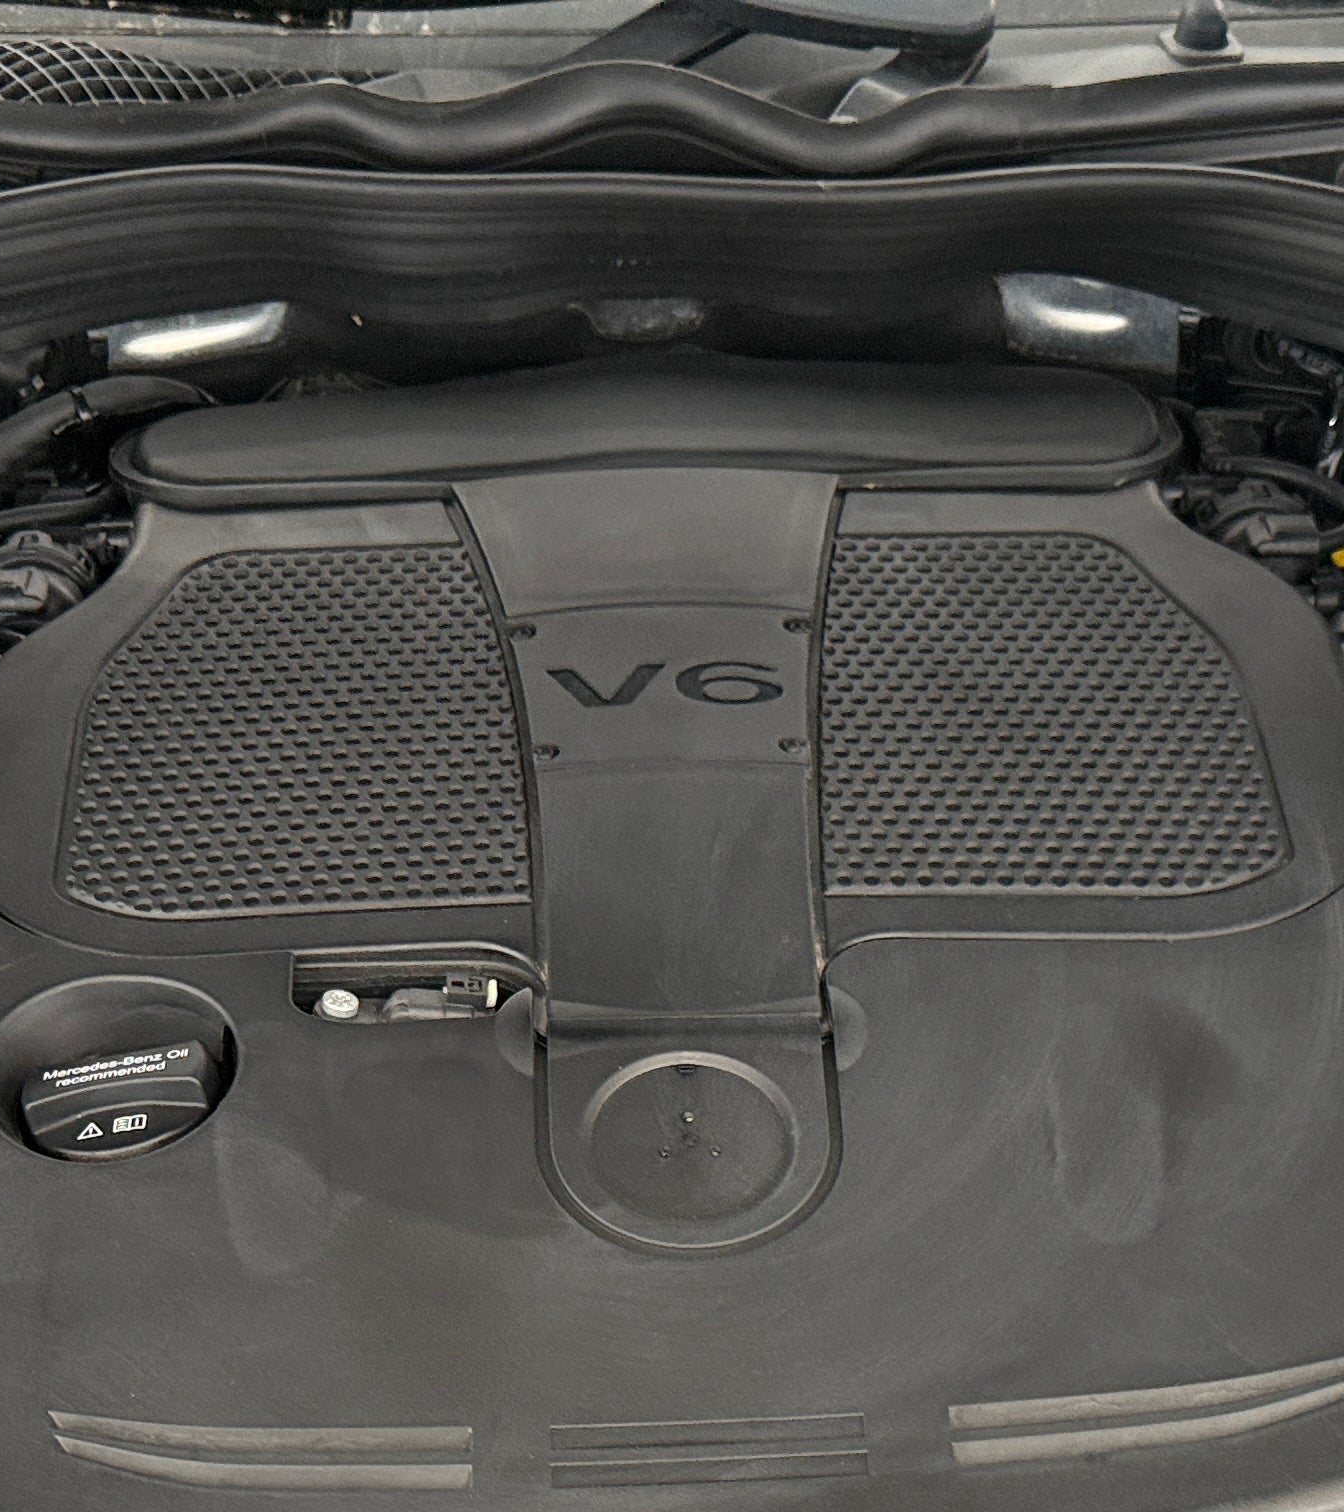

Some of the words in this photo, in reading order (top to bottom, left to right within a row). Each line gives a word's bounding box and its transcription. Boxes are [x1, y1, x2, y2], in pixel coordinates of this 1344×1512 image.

[545, 661, 784, 708] V6
[42, 1053, 163, 1081] Mercedes-Benz
[166, 1048, 189, 1060] Oil
[55, 1060, 167, 1088] recommended
